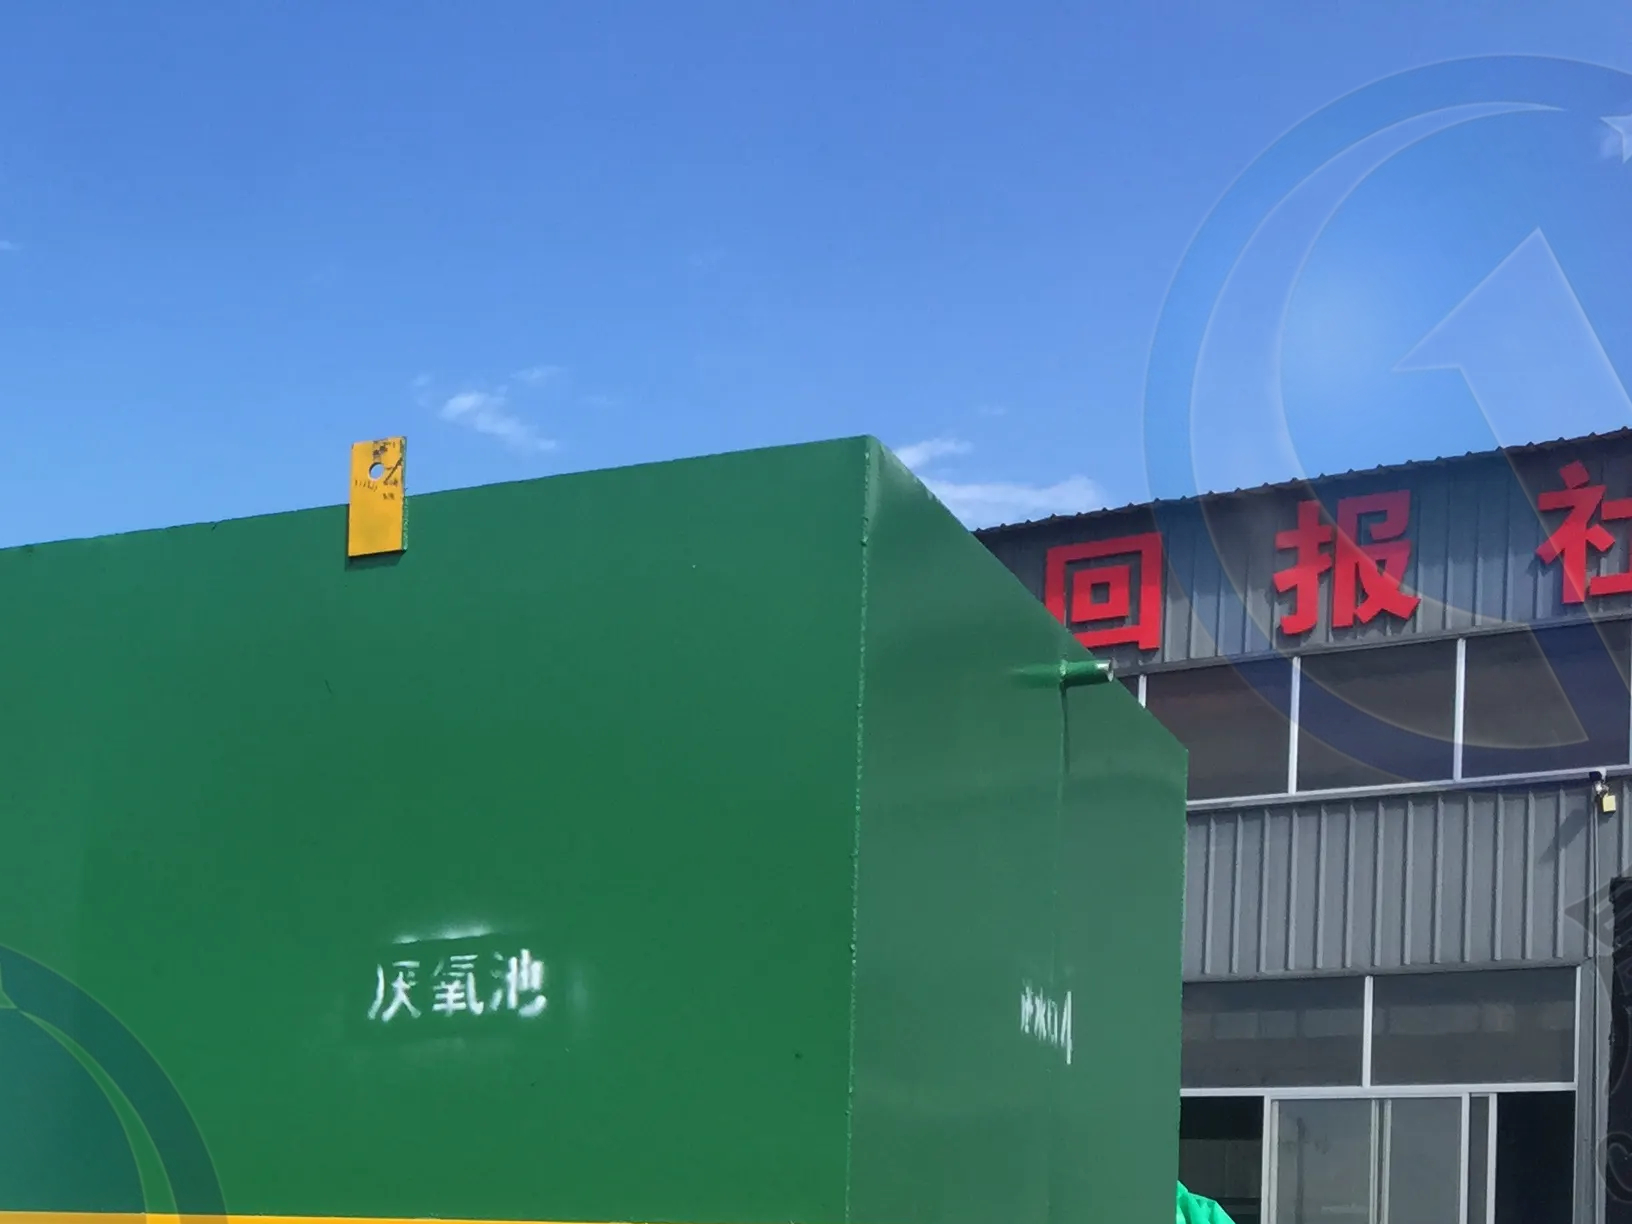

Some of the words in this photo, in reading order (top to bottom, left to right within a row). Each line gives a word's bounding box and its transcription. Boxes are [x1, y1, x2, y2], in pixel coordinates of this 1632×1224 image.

[1045, 460, 1632, 650] 回报社
[368, 948, 548, 1022] 厌氧池
